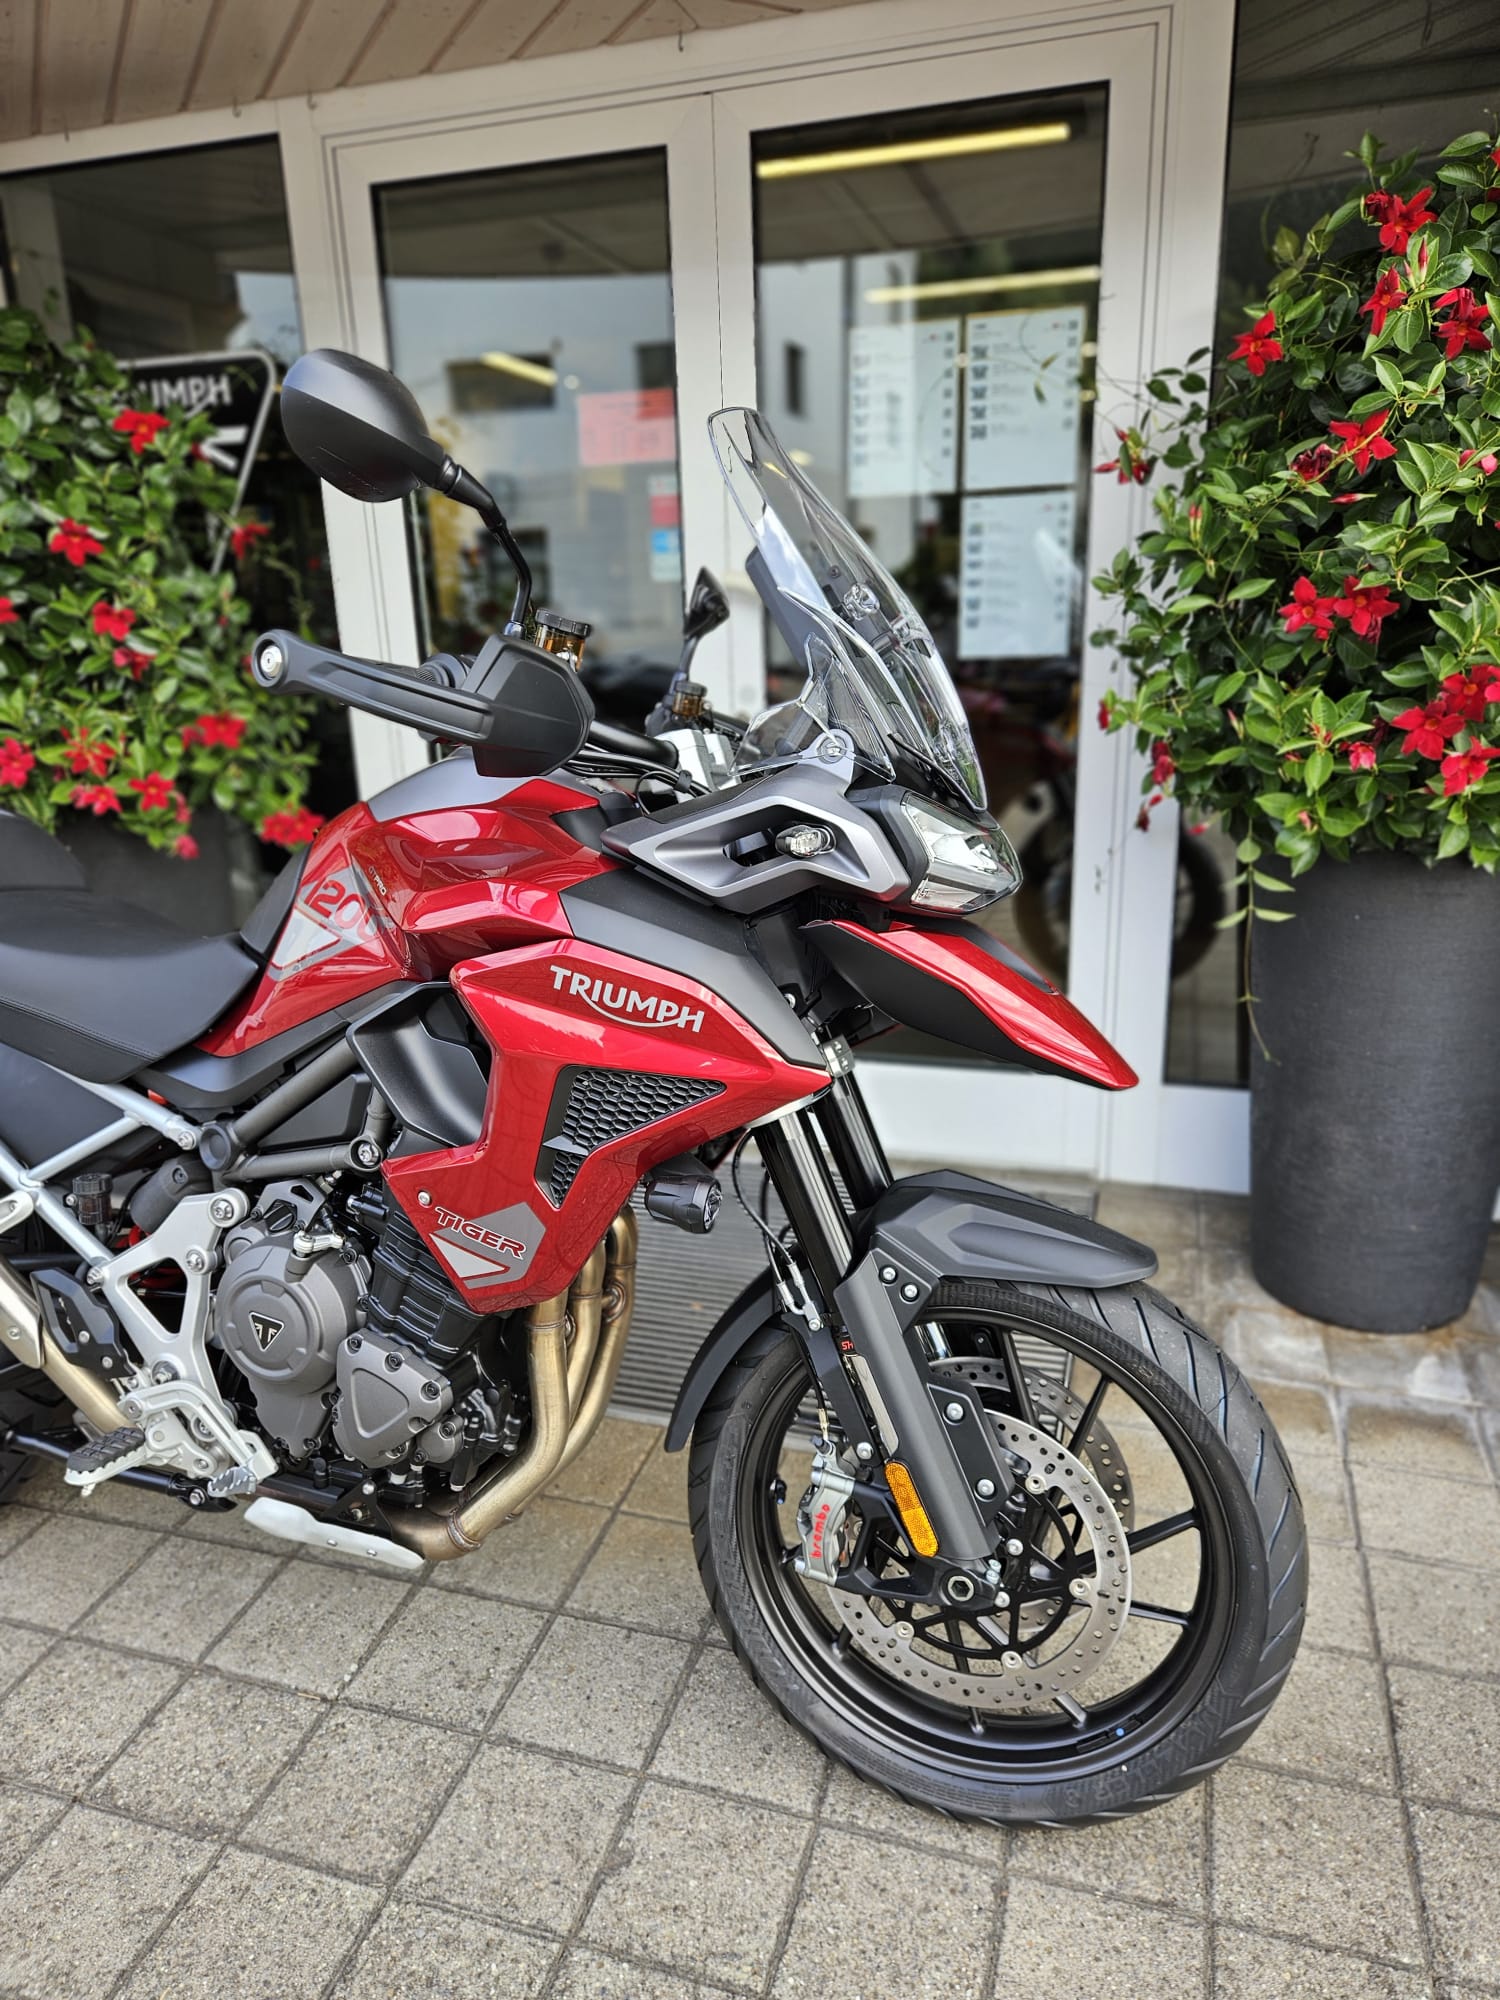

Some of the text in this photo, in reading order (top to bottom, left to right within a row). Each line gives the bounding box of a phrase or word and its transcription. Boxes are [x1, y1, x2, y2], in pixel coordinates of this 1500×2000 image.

[550, 965, 705, 1033] TRIUMPH
[435, 1207, 526, 1260] TIGER
[810, 1504, 831, 1559] brembo
